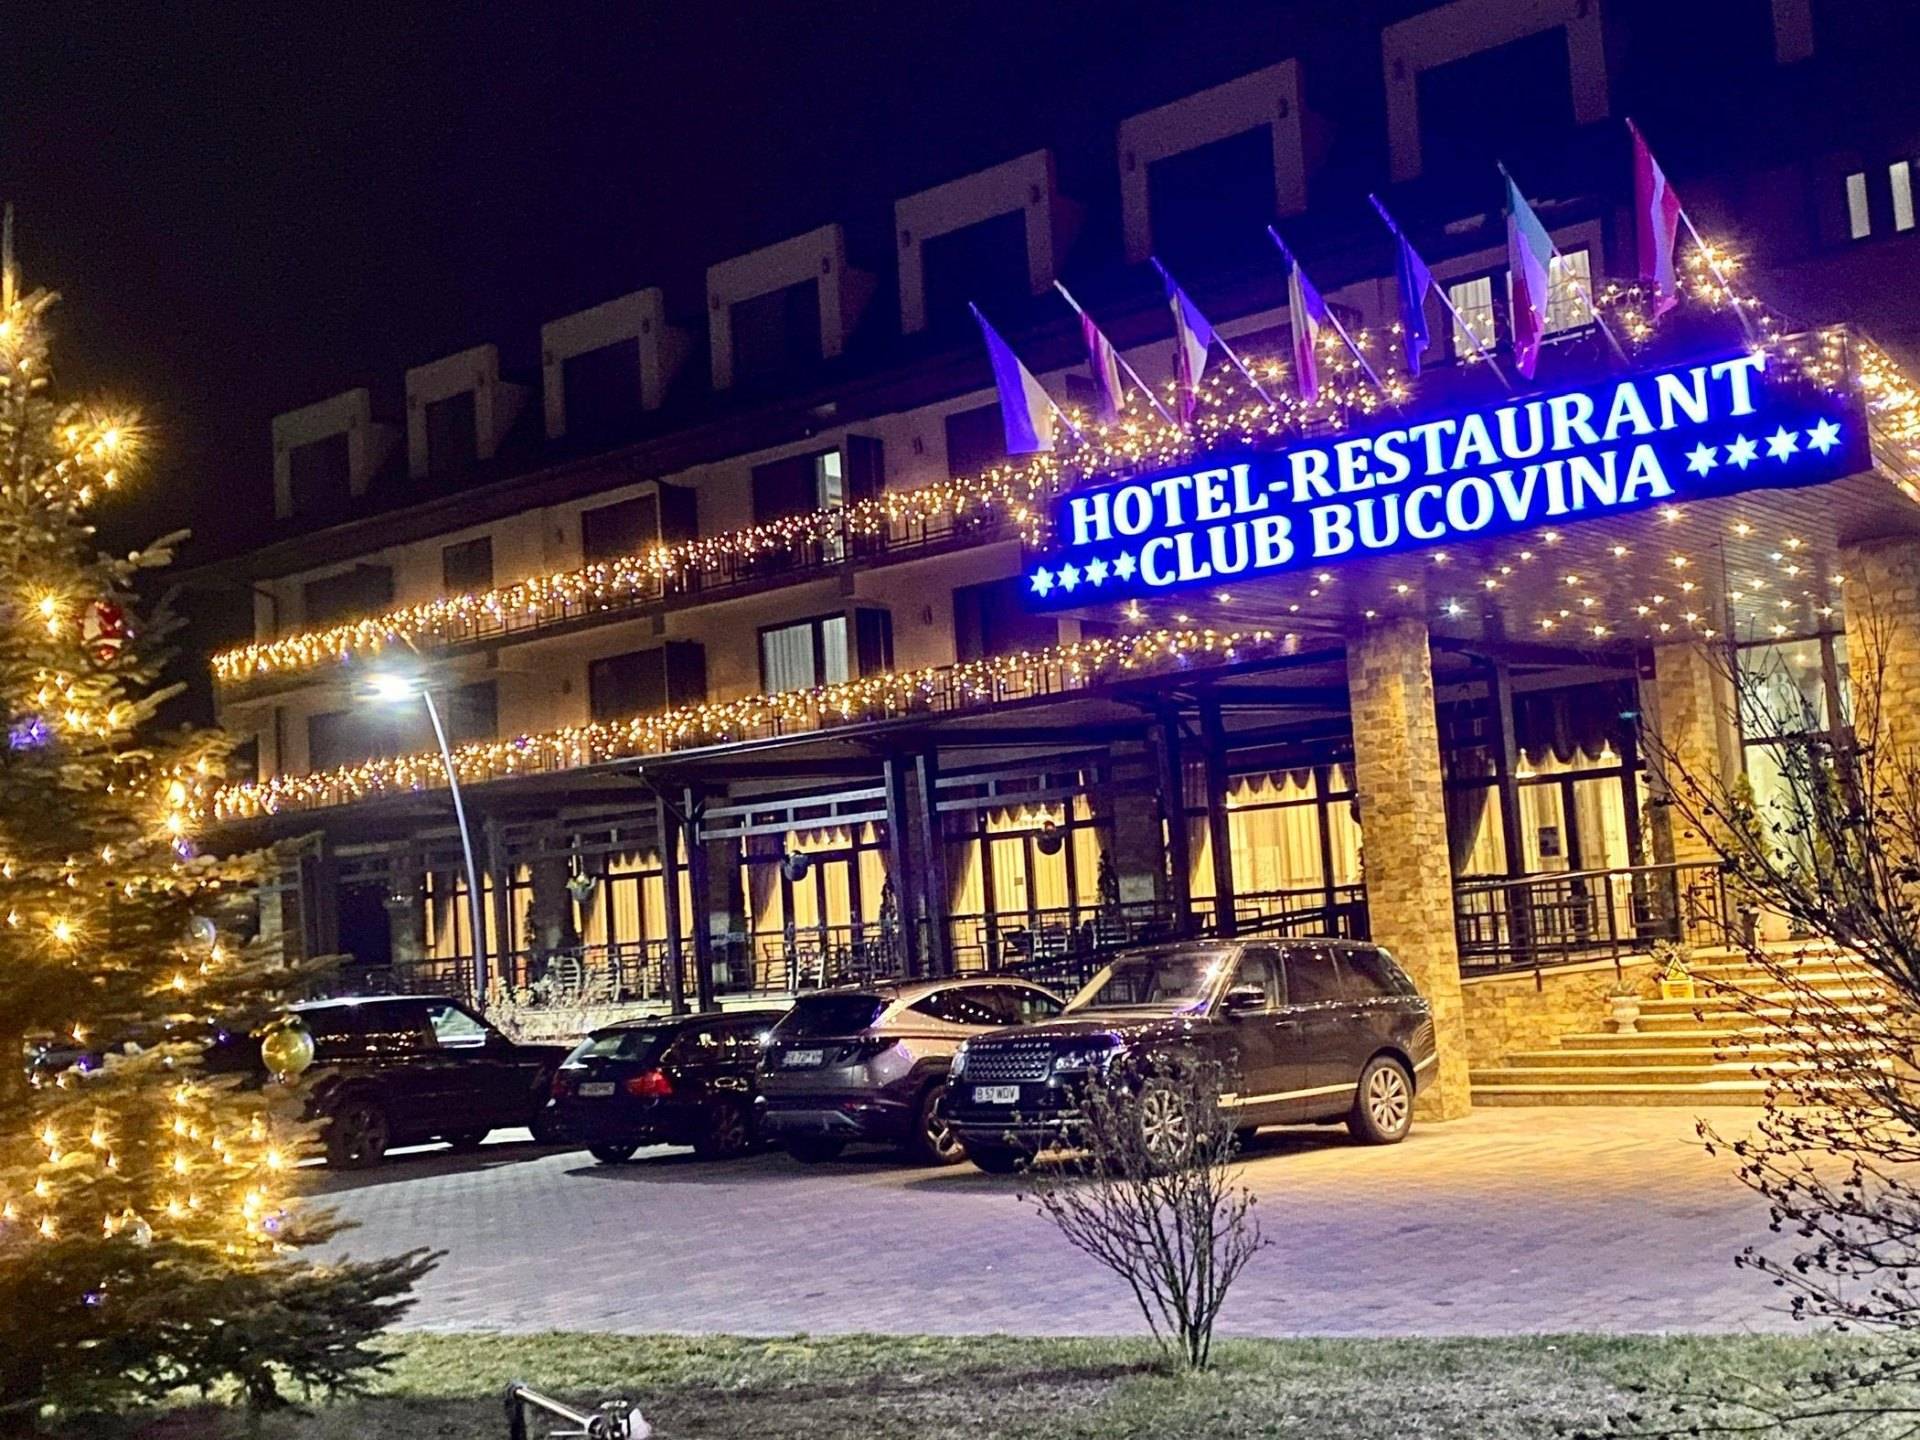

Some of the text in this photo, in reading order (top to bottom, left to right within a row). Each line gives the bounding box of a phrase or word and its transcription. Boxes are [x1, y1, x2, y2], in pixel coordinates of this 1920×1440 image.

[1070, 351, 1766, 546] HOTEL-RESTAURANT
[1139, 443, 1676, 586] CLUB BUCOVINA
